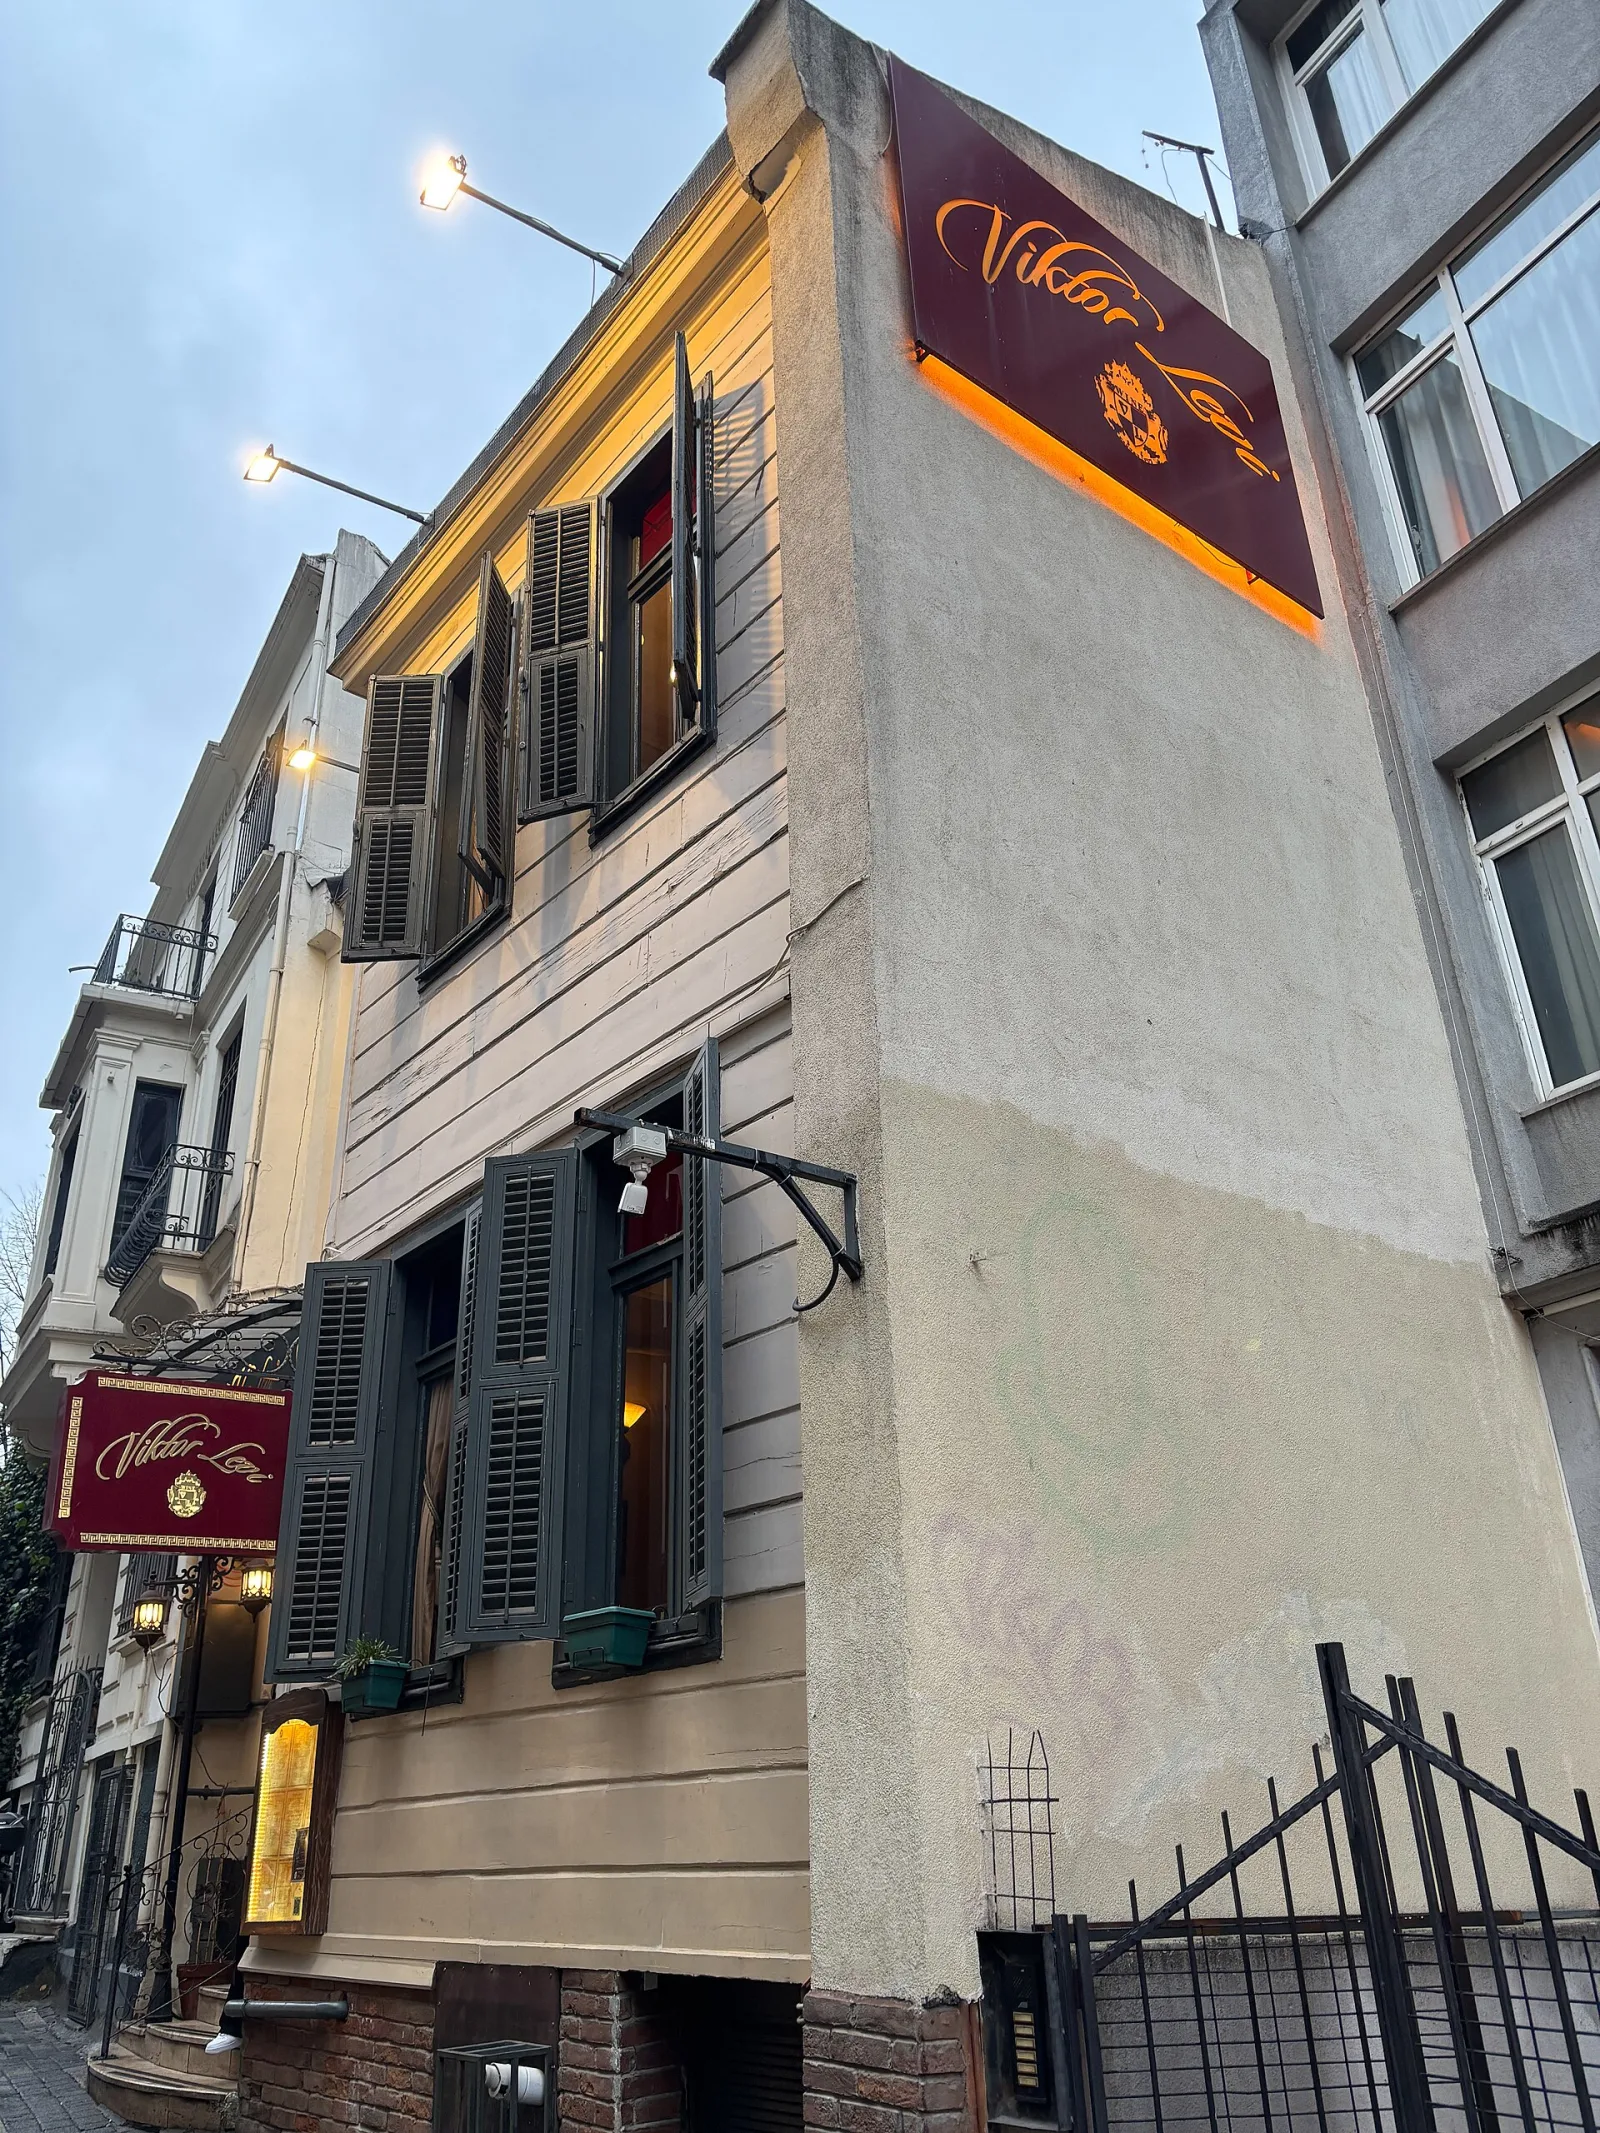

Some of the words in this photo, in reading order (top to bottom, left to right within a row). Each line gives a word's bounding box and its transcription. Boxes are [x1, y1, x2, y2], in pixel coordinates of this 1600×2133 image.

[935, 198, 1165, 332] Viktor
[1134, 342, 1281, 482] Levi
[96, 1414, 221, 1480] Viktor
[197, 1443, 274, 1483] Levi
